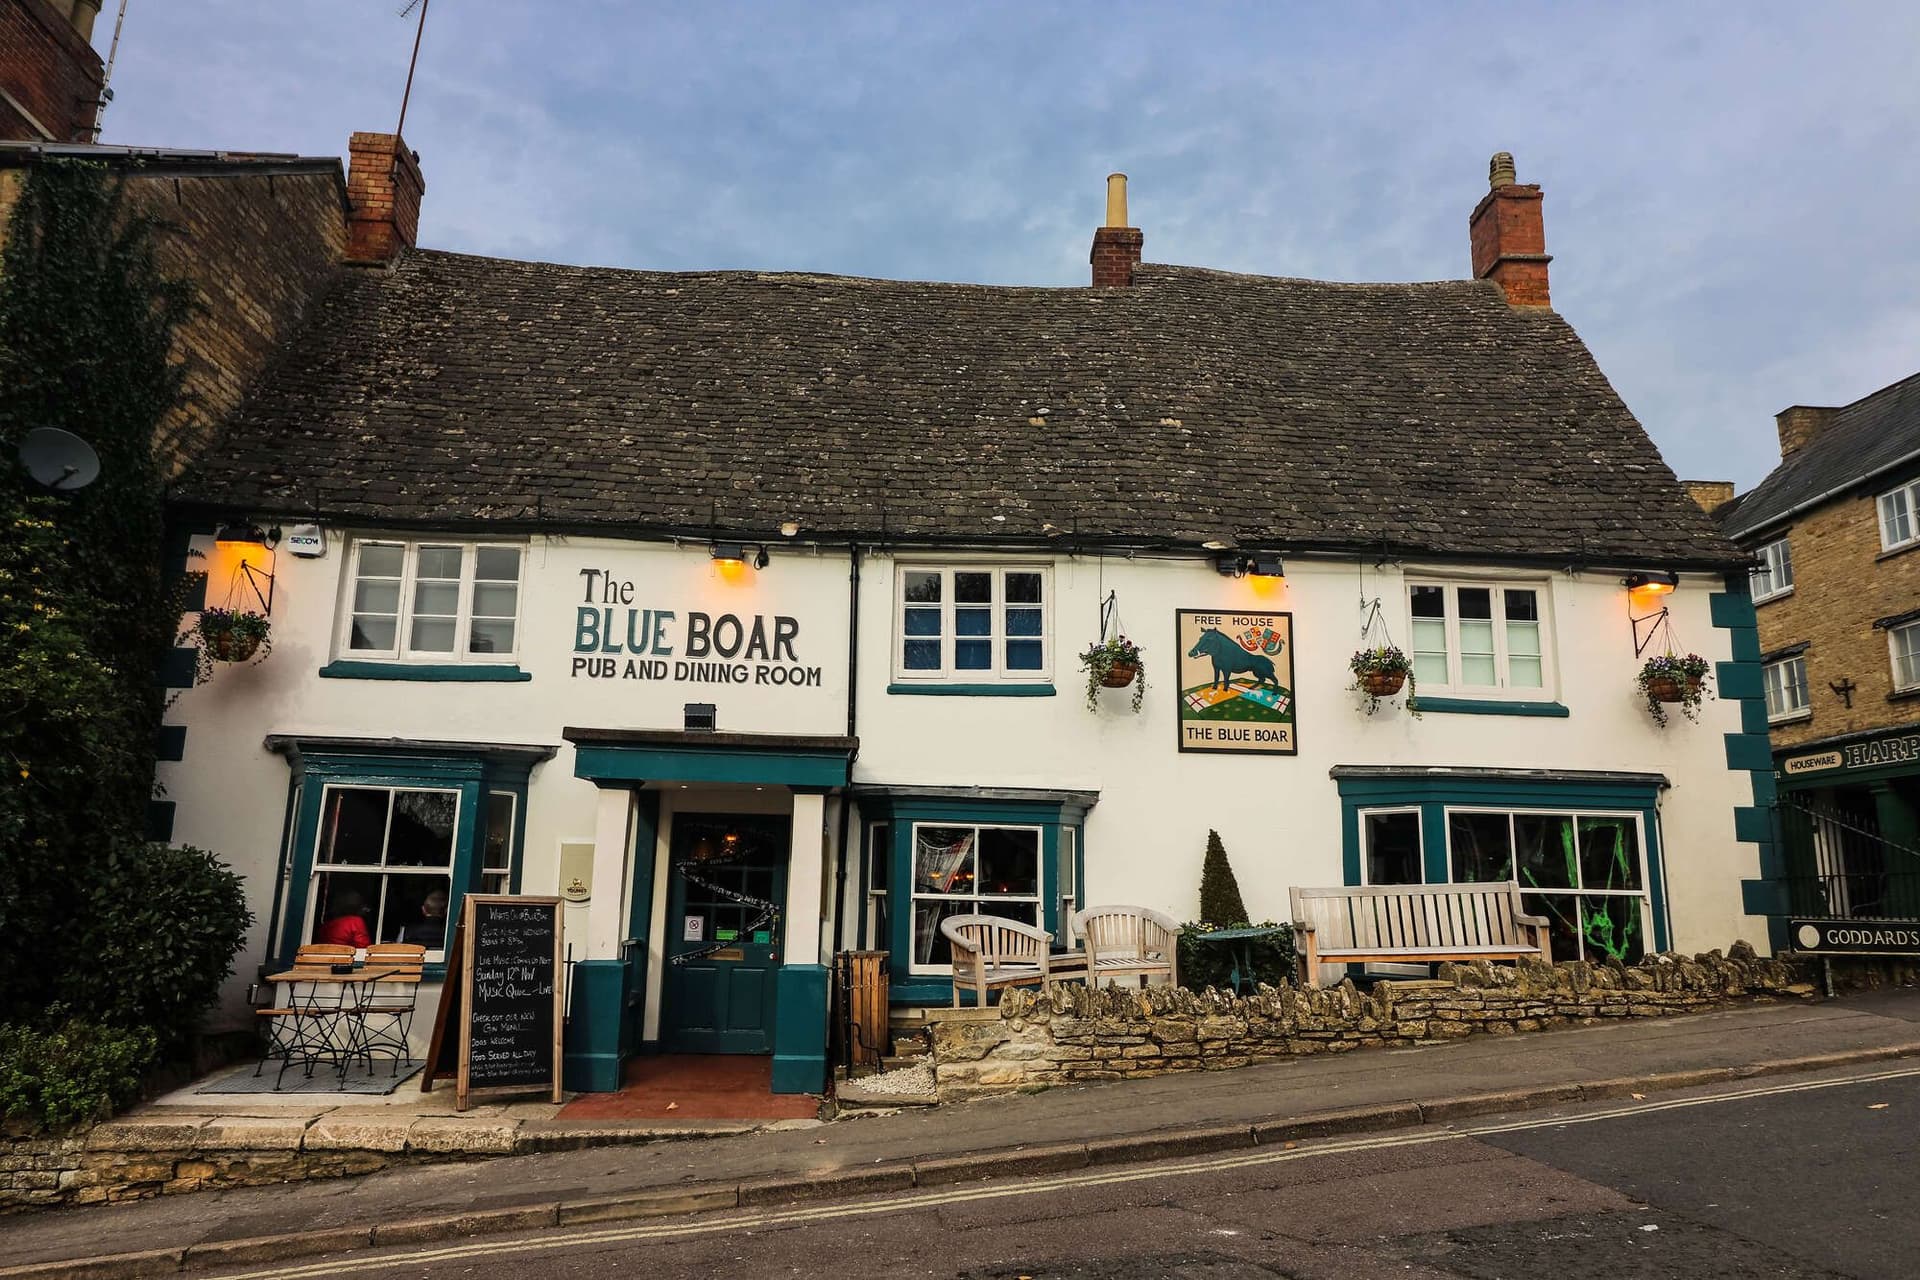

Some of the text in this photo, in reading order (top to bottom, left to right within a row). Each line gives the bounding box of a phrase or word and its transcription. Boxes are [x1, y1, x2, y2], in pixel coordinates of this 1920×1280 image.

[290, 536, 319, 545] SECOM
[580, 568, 635, 605] The
[1194, 615, 1274, 627] FREE HOUSE
[574, 606, 799, 662] BLUE BOAR
[571, 657, 822, 687] PUB AND DINING ROOM
[1186, 727, 1289, 743] THE BLUE BOAR
[1790, 755, 1836, 771] HOUSEWARE
[1826, 929, 1920, 946] GODDARD'S
[476, 966, 505, 987] Sunday
[487, 1050, 511, 1061] SERVED
